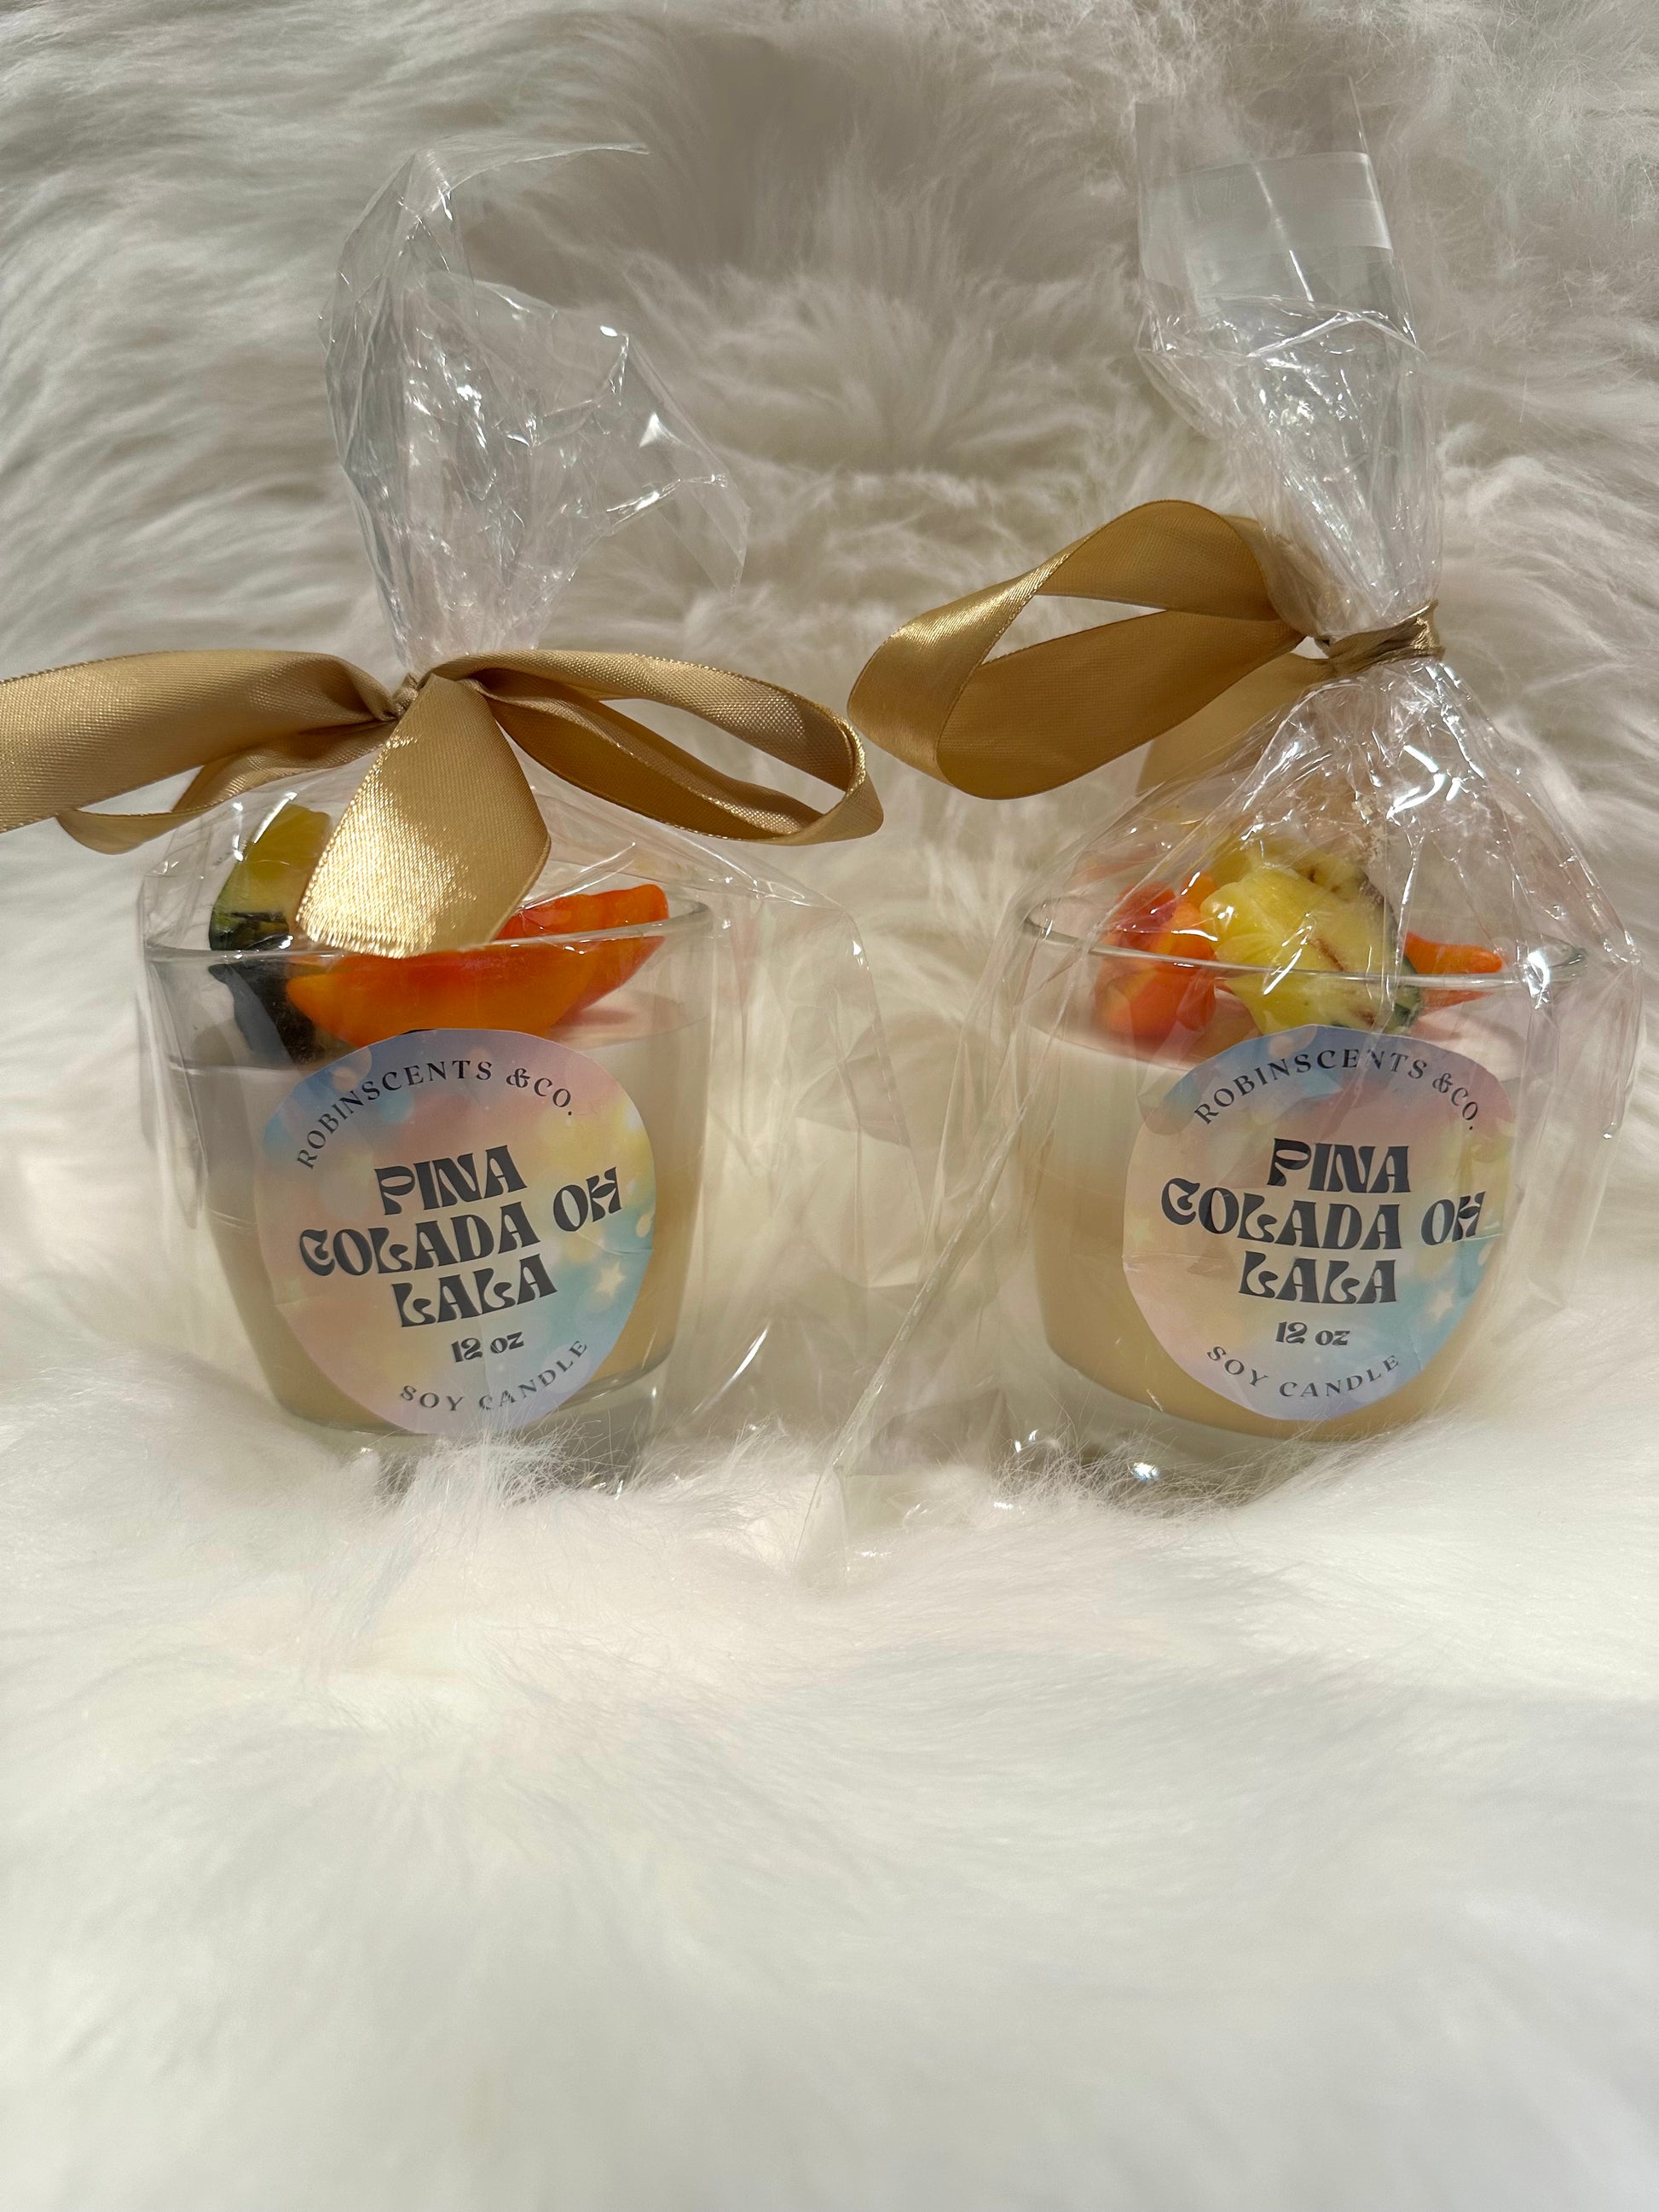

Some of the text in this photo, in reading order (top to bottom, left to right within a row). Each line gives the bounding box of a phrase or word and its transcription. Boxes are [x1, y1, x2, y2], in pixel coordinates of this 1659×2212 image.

[297, 1060, 493, 1170] ROBINSCENTS
[1194, 1048, 1427, 1124] ROBINSCENTS
[374, 1145, 528, 1216] PINA
[1267, 1138, 1410, 1193] PINA
[299, 1167, 622, 1276] COLADA OH
[1161, 1178, 1486, 1250] COLADA OH
[391, 1253, 557, 1327] LALA
[1239, 1250, 1397, 1304] LALA
[451, 1337, 483, 1362] 12
[1275, 1321, 1308, 1344] 12
[401, 1340, 587, 1412] SOY CANDLE
[1207, 1346, 1399, 1398] SOY CANDLE
